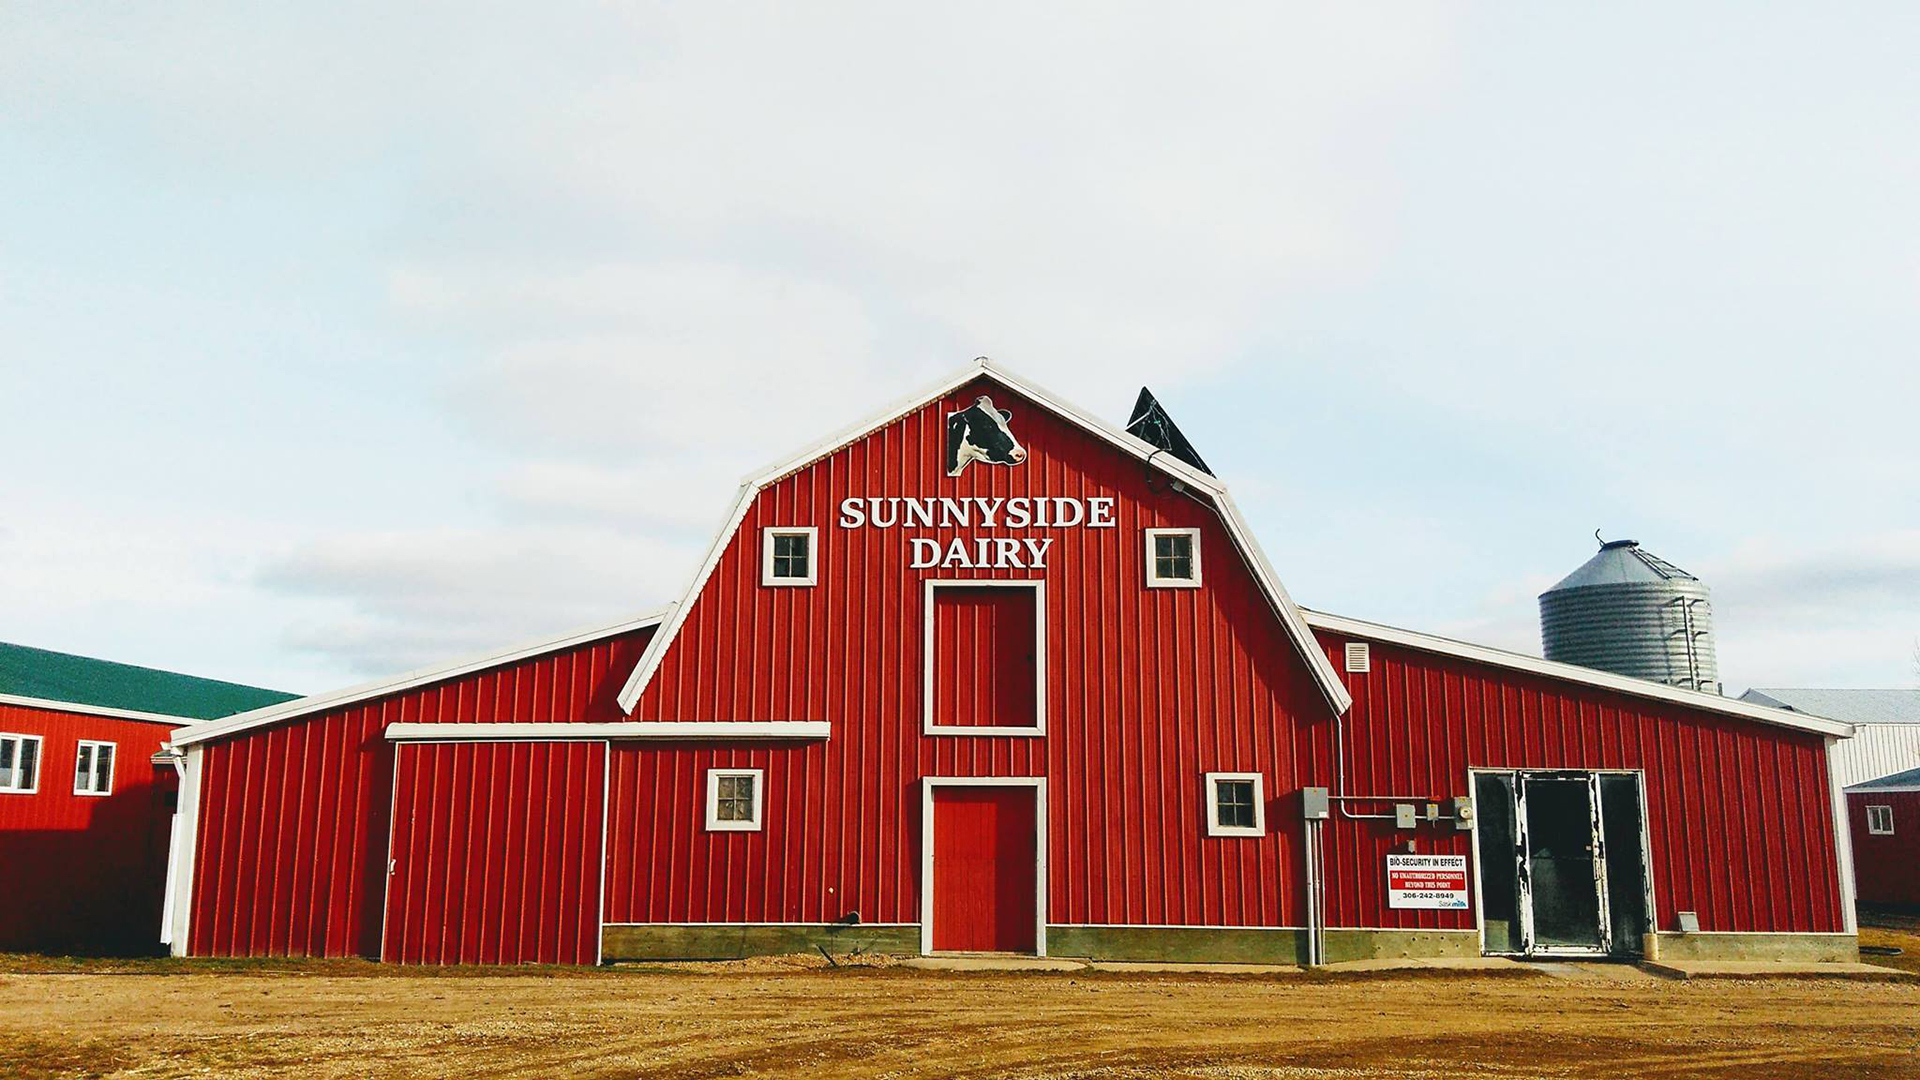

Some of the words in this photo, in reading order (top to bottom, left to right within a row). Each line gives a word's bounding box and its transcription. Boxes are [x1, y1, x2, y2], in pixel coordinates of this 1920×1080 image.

[840, 497, 1116, 528] SUNNYSIDE
[910, 538, 1053, 568] DAIRY
[1390, 857, 1431, 866] BIO-SECURITY
[1432, 858, 1439, 866] IN
[1440, 858, 1463, 867] EFFECT
